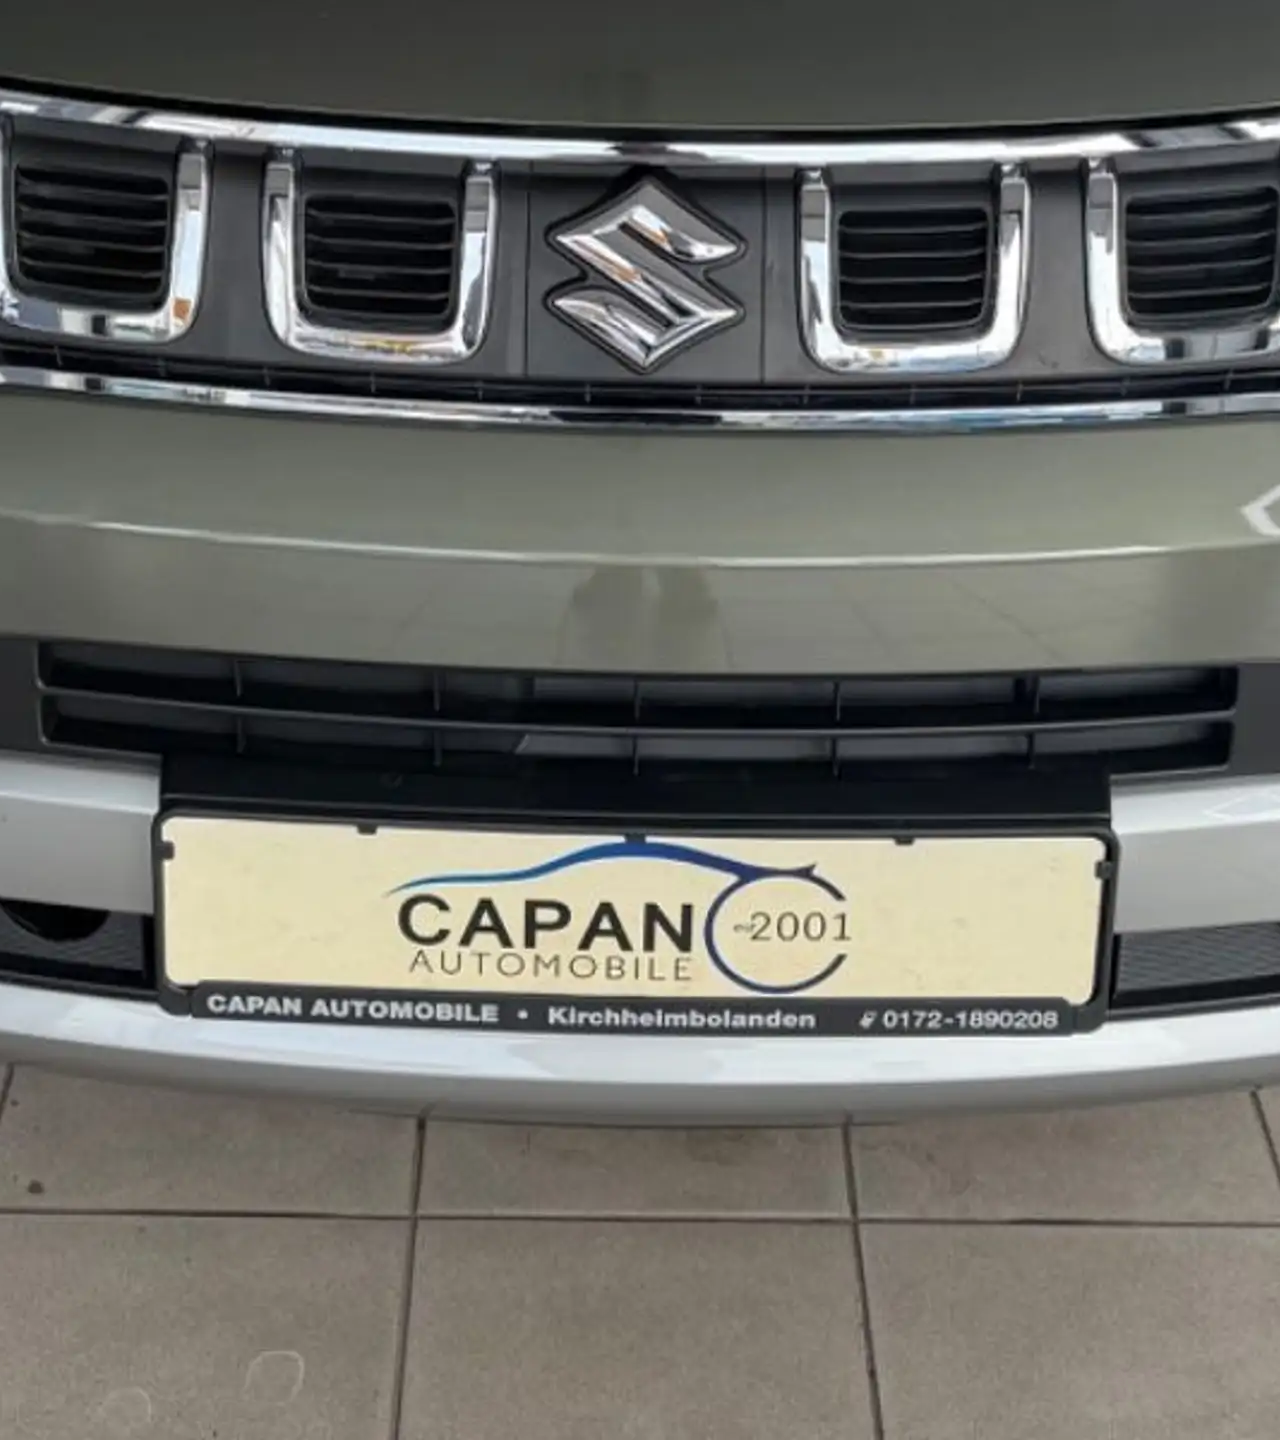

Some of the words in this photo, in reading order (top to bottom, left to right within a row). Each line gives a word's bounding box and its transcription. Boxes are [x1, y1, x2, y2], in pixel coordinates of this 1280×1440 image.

[397, 893, 693, 953] CAPAN
[749, 910, 852, 942] 2001
[408, 951, 693, 981] AUTOMOBILE
[206, 994, 302, 1016] CAPAN
[310, 998, 500, 1023] AUTOMOBILE
[882, 1008, 1059, 1030] 0172-1890208
